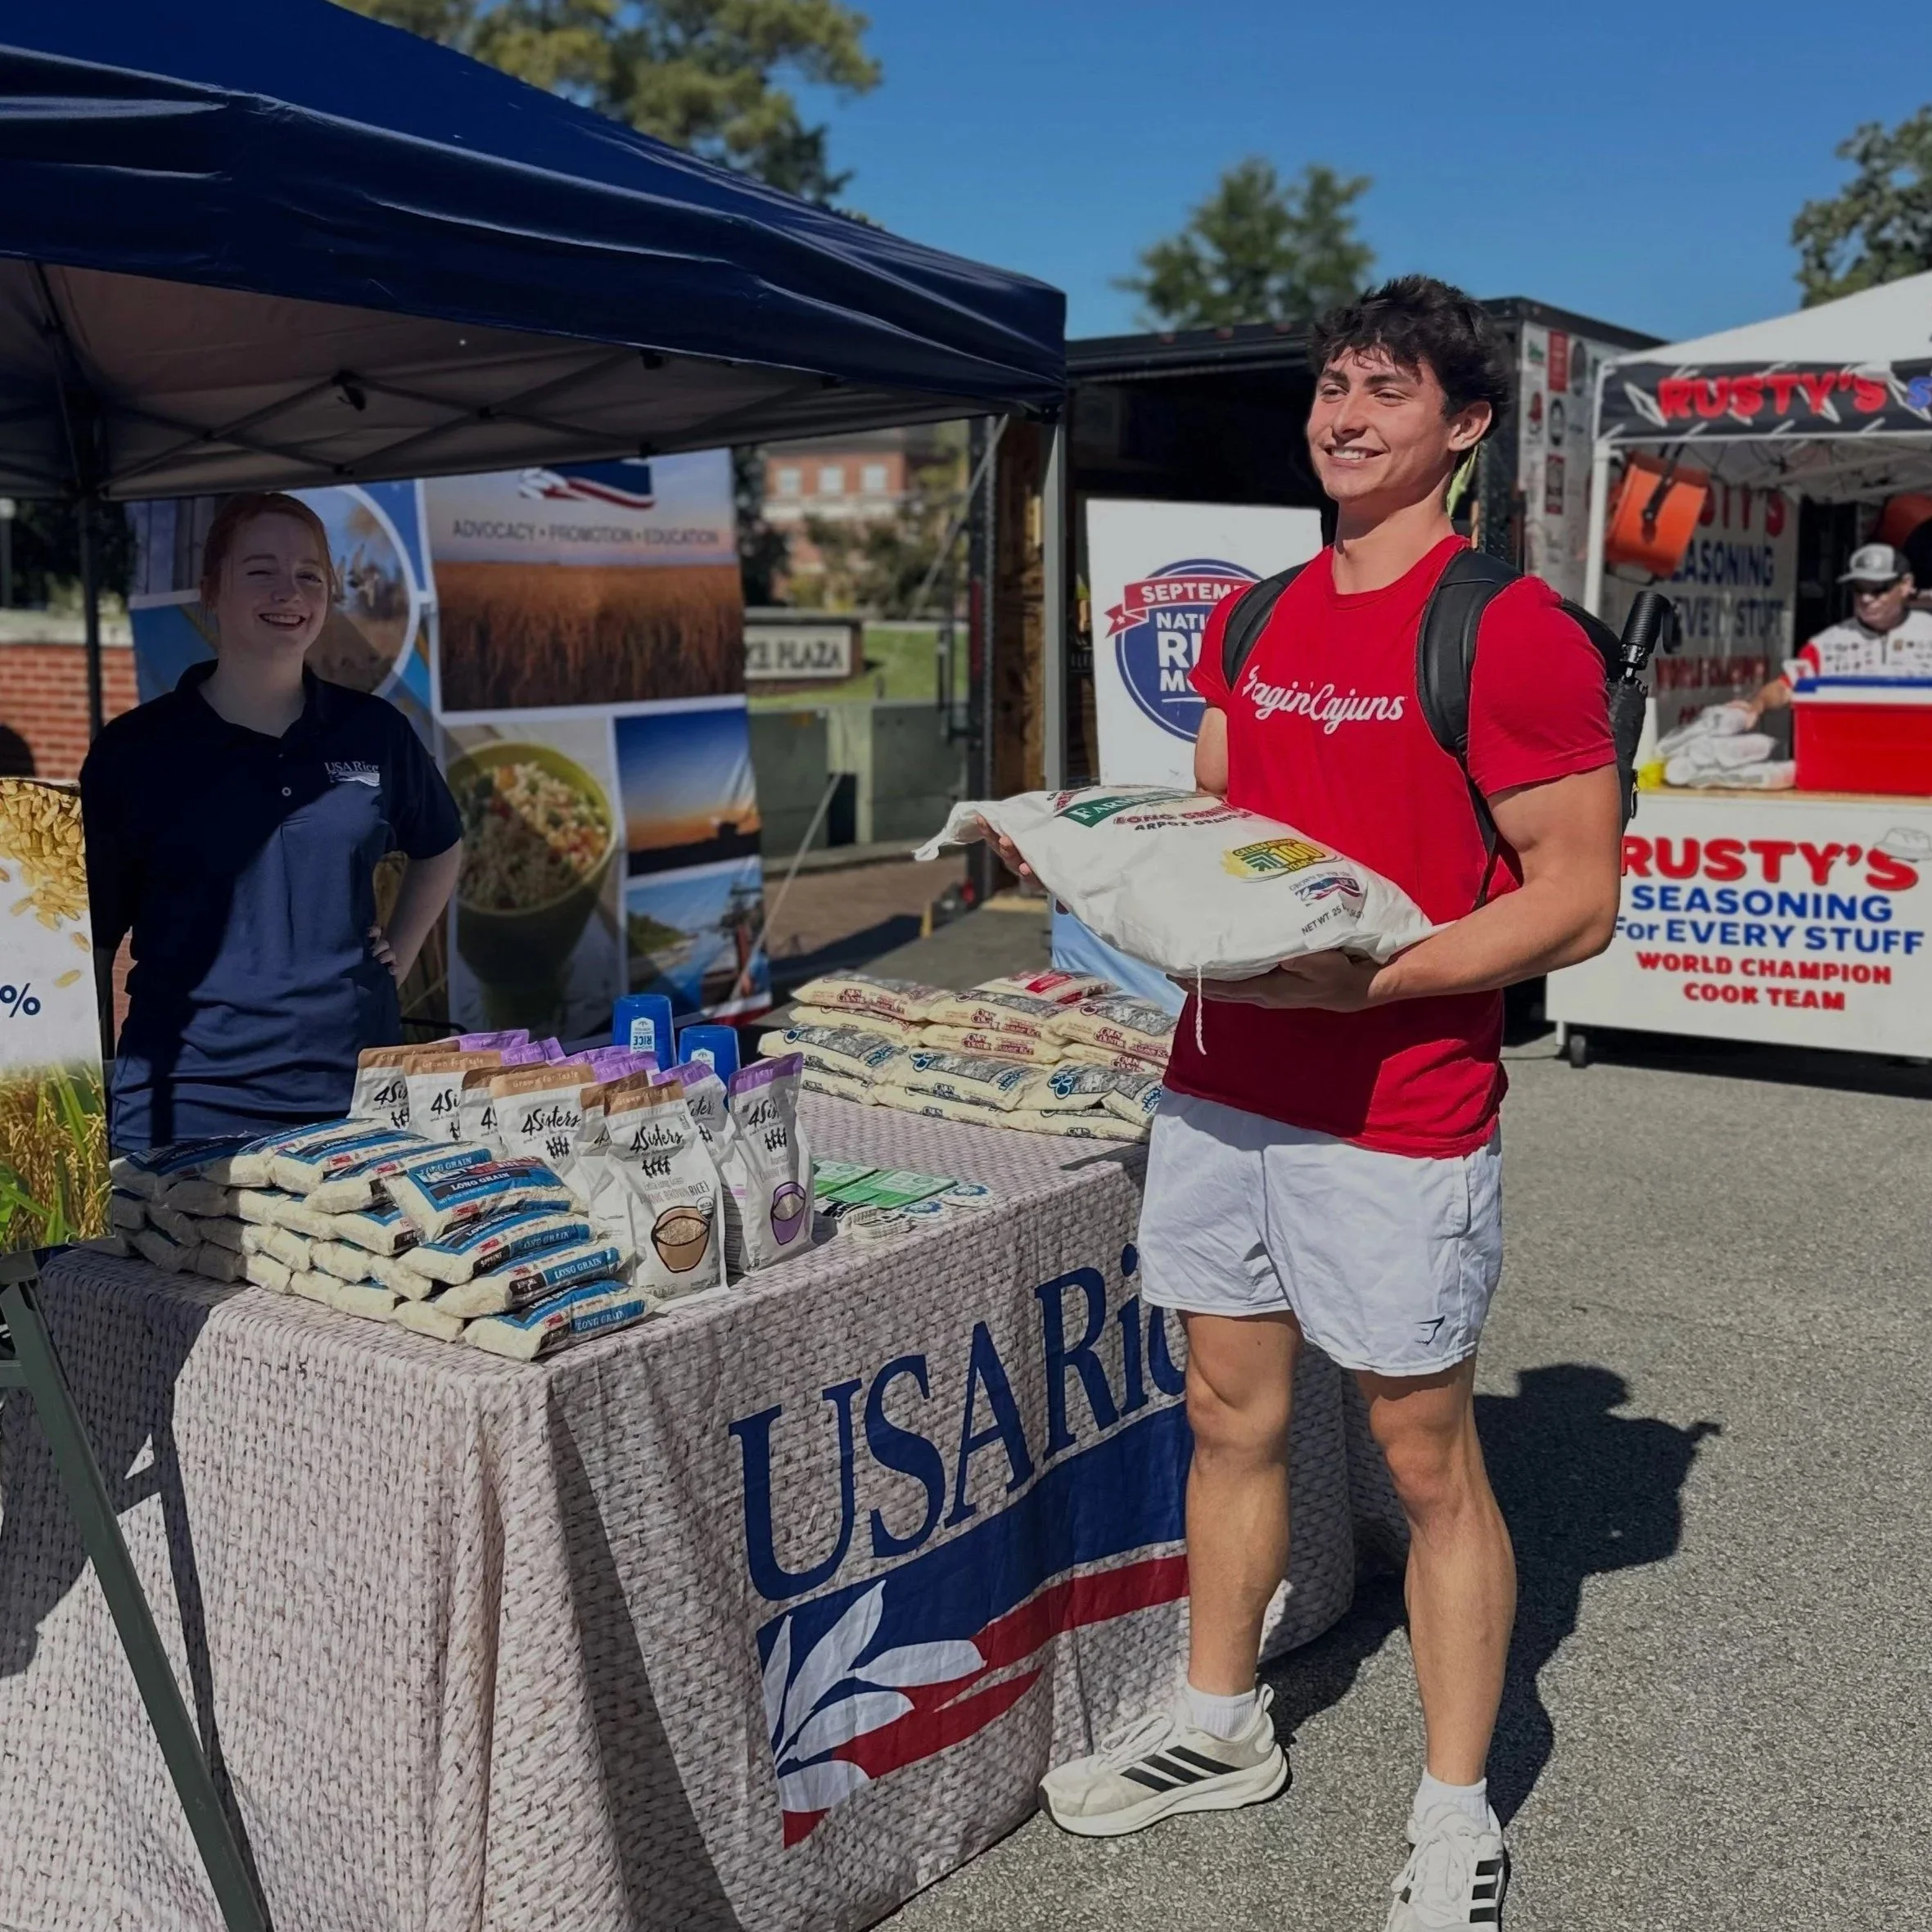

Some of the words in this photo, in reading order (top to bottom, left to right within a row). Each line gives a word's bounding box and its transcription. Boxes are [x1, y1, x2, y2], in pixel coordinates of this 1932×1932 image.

[1657, 371, 1888, 420] RUSTY'S
[454, 520, 536, 541] ADVOCACY
[1141, 582, 1238, 603] SEPTEM
[1156, 612, 1207, 630] NATI
[1158, 631, 1203, 668] RI
[1310, 683, 1406, 734] Cajuns
[324, 761, 352, 774] USA
[1270, 843, 1325, 863] 100
[1621, 835, 1919, 892] RUSTY'S
[1631, 884, 1893, 923] SEASONING
[1666, 919, 1796, 949] EVERY
[1804, 926, 1925, 955] STUFF
[1636, 951, 1733, 975] WORLD
[1740, 958, 1892, 985] CHAMPION
[1682, 982, 1759, 1005] COOK
[1767, 987, 1845, 1011] TEAM
[633, 1035, 652, 1046] RICE
[521, 1105, 581, 1136] 4Sisters
[630, 1122, 684, 1155] 4Sisters
[445, 1157, 472, 1170] GRAIN
[451, 1179, 479, 1191] LONG
[480, 1172, 510, 1184] GRAIN
[554, 1266, 576, 1279] LONG
[576, 1257, 603, 1271] GRAIN
[729, 1320, 1035, 1601] USA
[1035, 1244, 1186, 1462] Ric
